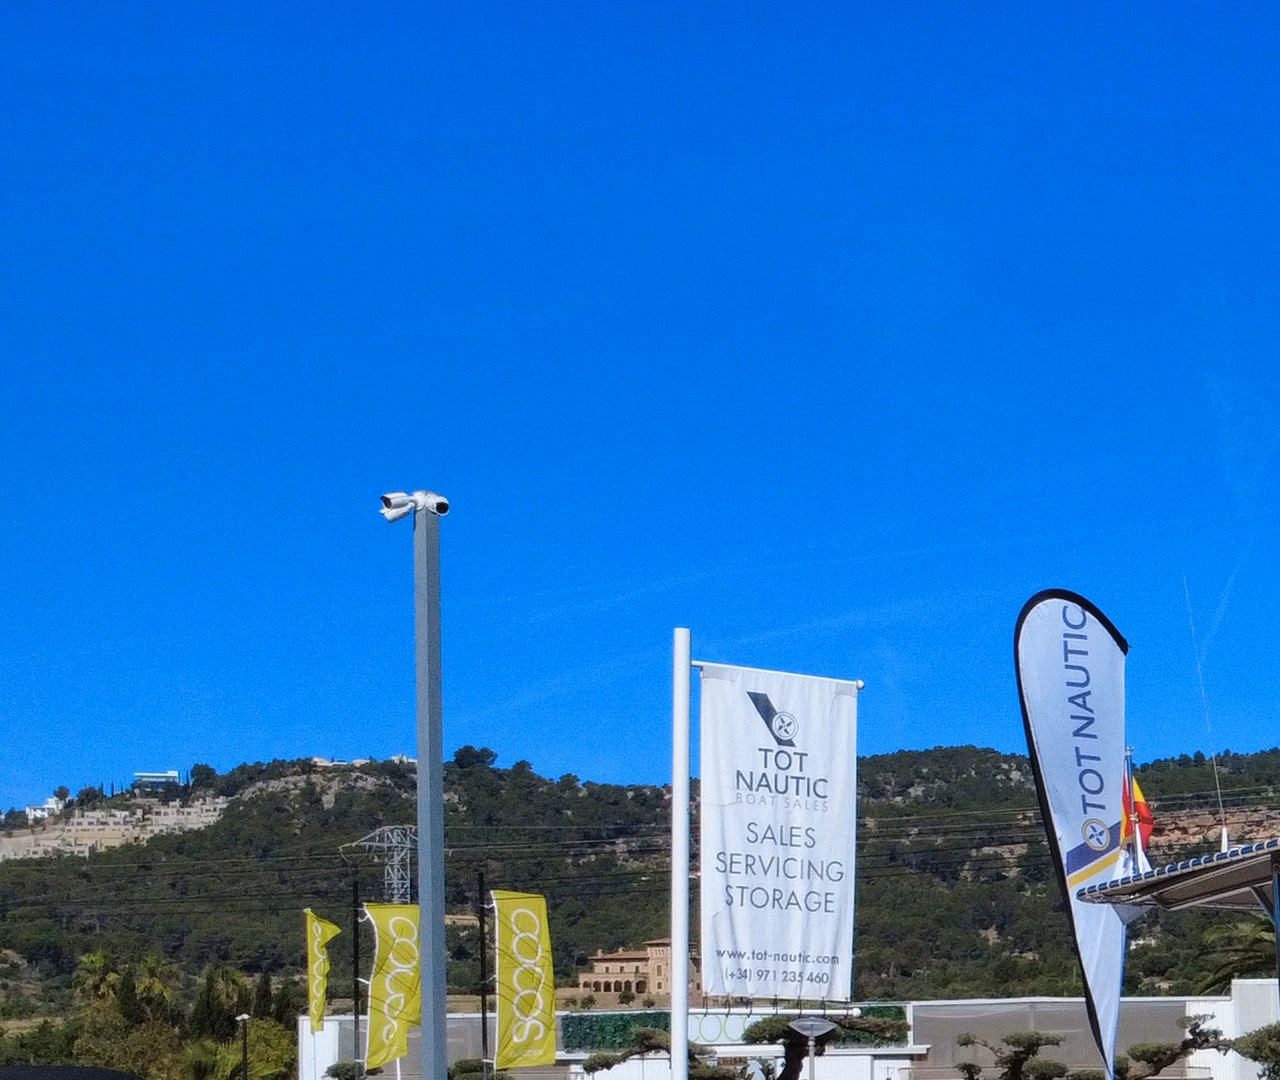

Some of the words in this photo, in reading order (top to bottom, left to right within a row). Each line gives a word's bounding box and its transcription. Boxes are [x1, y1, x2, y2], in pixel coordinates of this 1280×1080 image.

[1062, 605, 1098, 739] NAUTIC
[758, 748, 809, 772] TOT
[736, 770, 828, 799] NAUTIC
[1075, 746, 1106, 815] TOT
[736, 793, 777, 806] BOAT
[784, 798, 829, 812] SALES
[746, 822, 816, 848] SALES
[715, 852, 844, 882] SERVICING
[725, 885, 835, 913] STORAGE
[757, 970, 777, 981] 971
[782, 971, 804, 982] 235
[806, 972, 829, 984] 460
